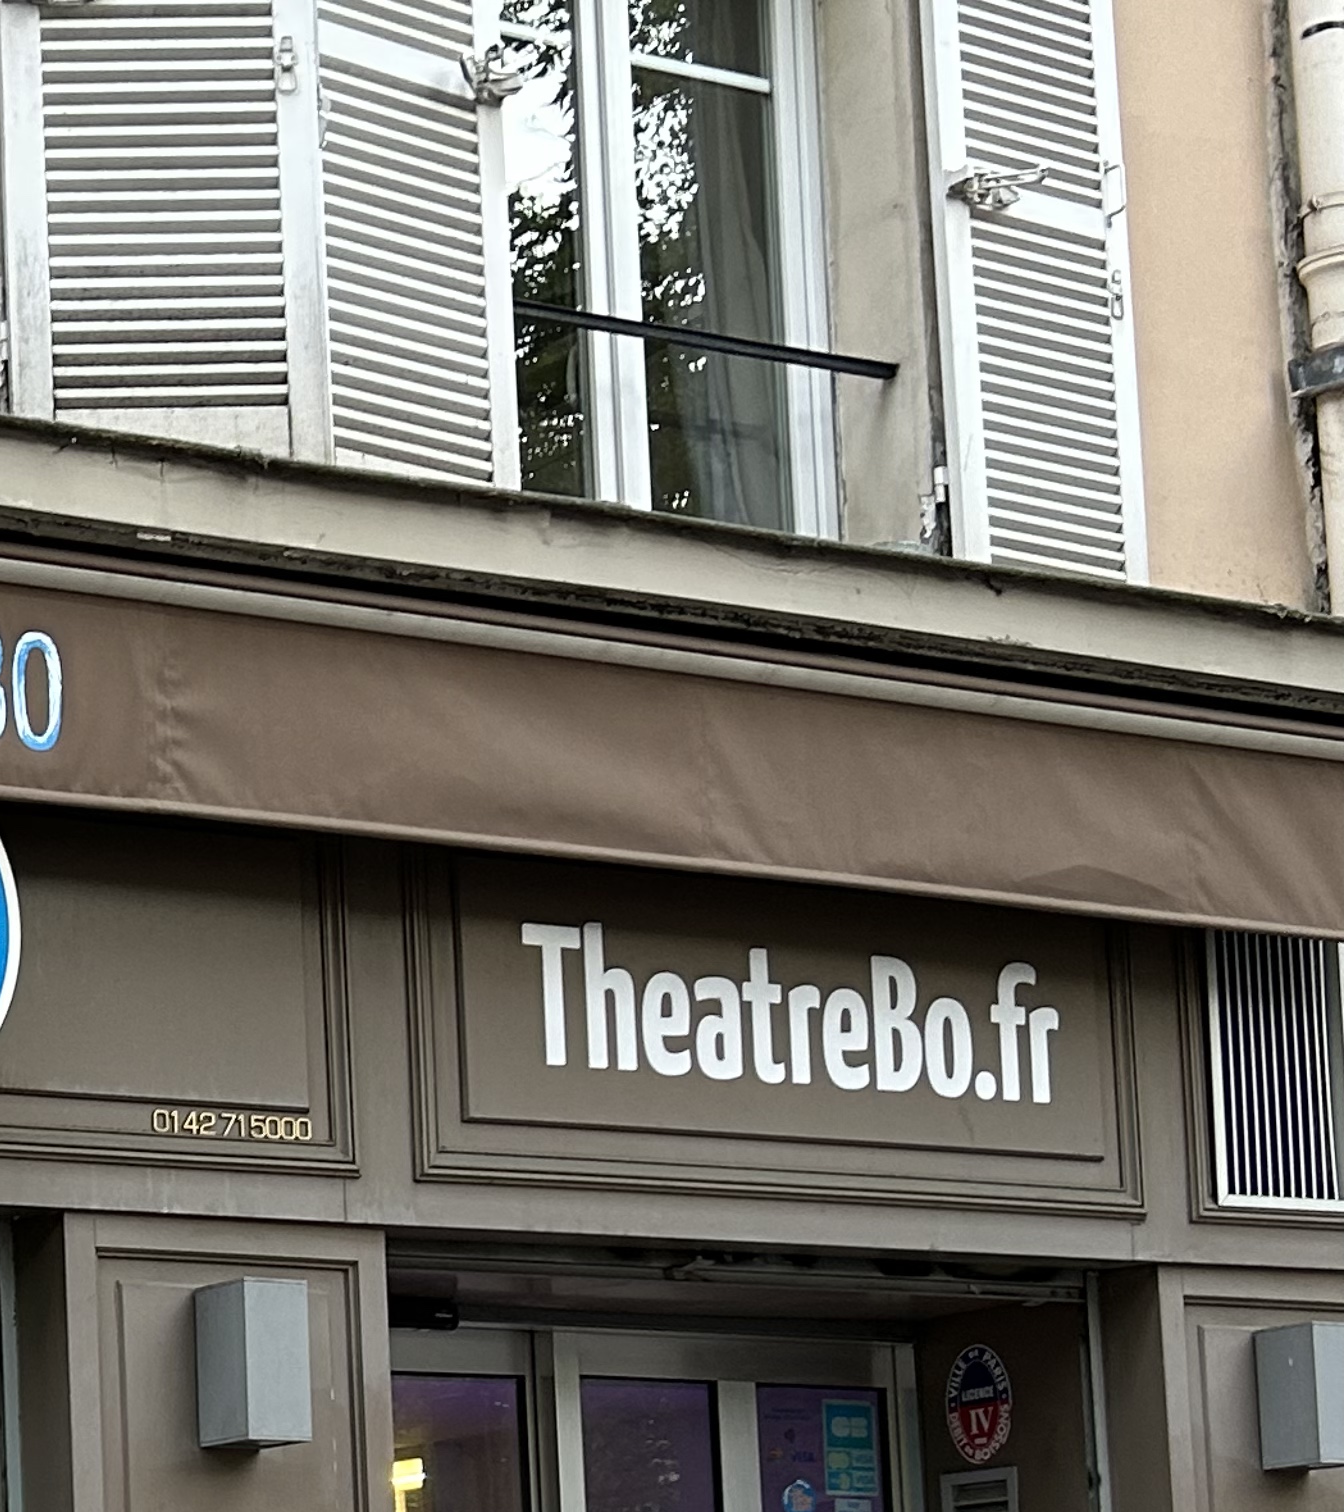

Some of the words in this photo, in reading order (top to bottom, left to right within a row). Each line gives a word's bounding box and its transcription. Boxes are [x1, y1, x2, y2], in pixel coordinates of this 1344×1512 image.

[520, 921, 1060, 1105] TheatreBo.fr
[948, 1359, 967, 1398] VILLE
[983, 1351, 1007, 1391] PARIS
[962, 1385, 993, 1401] LICENCE
[969, 1406, 993, 1435] IV
[974, 1403, 1010, 1460] BOISSONS
